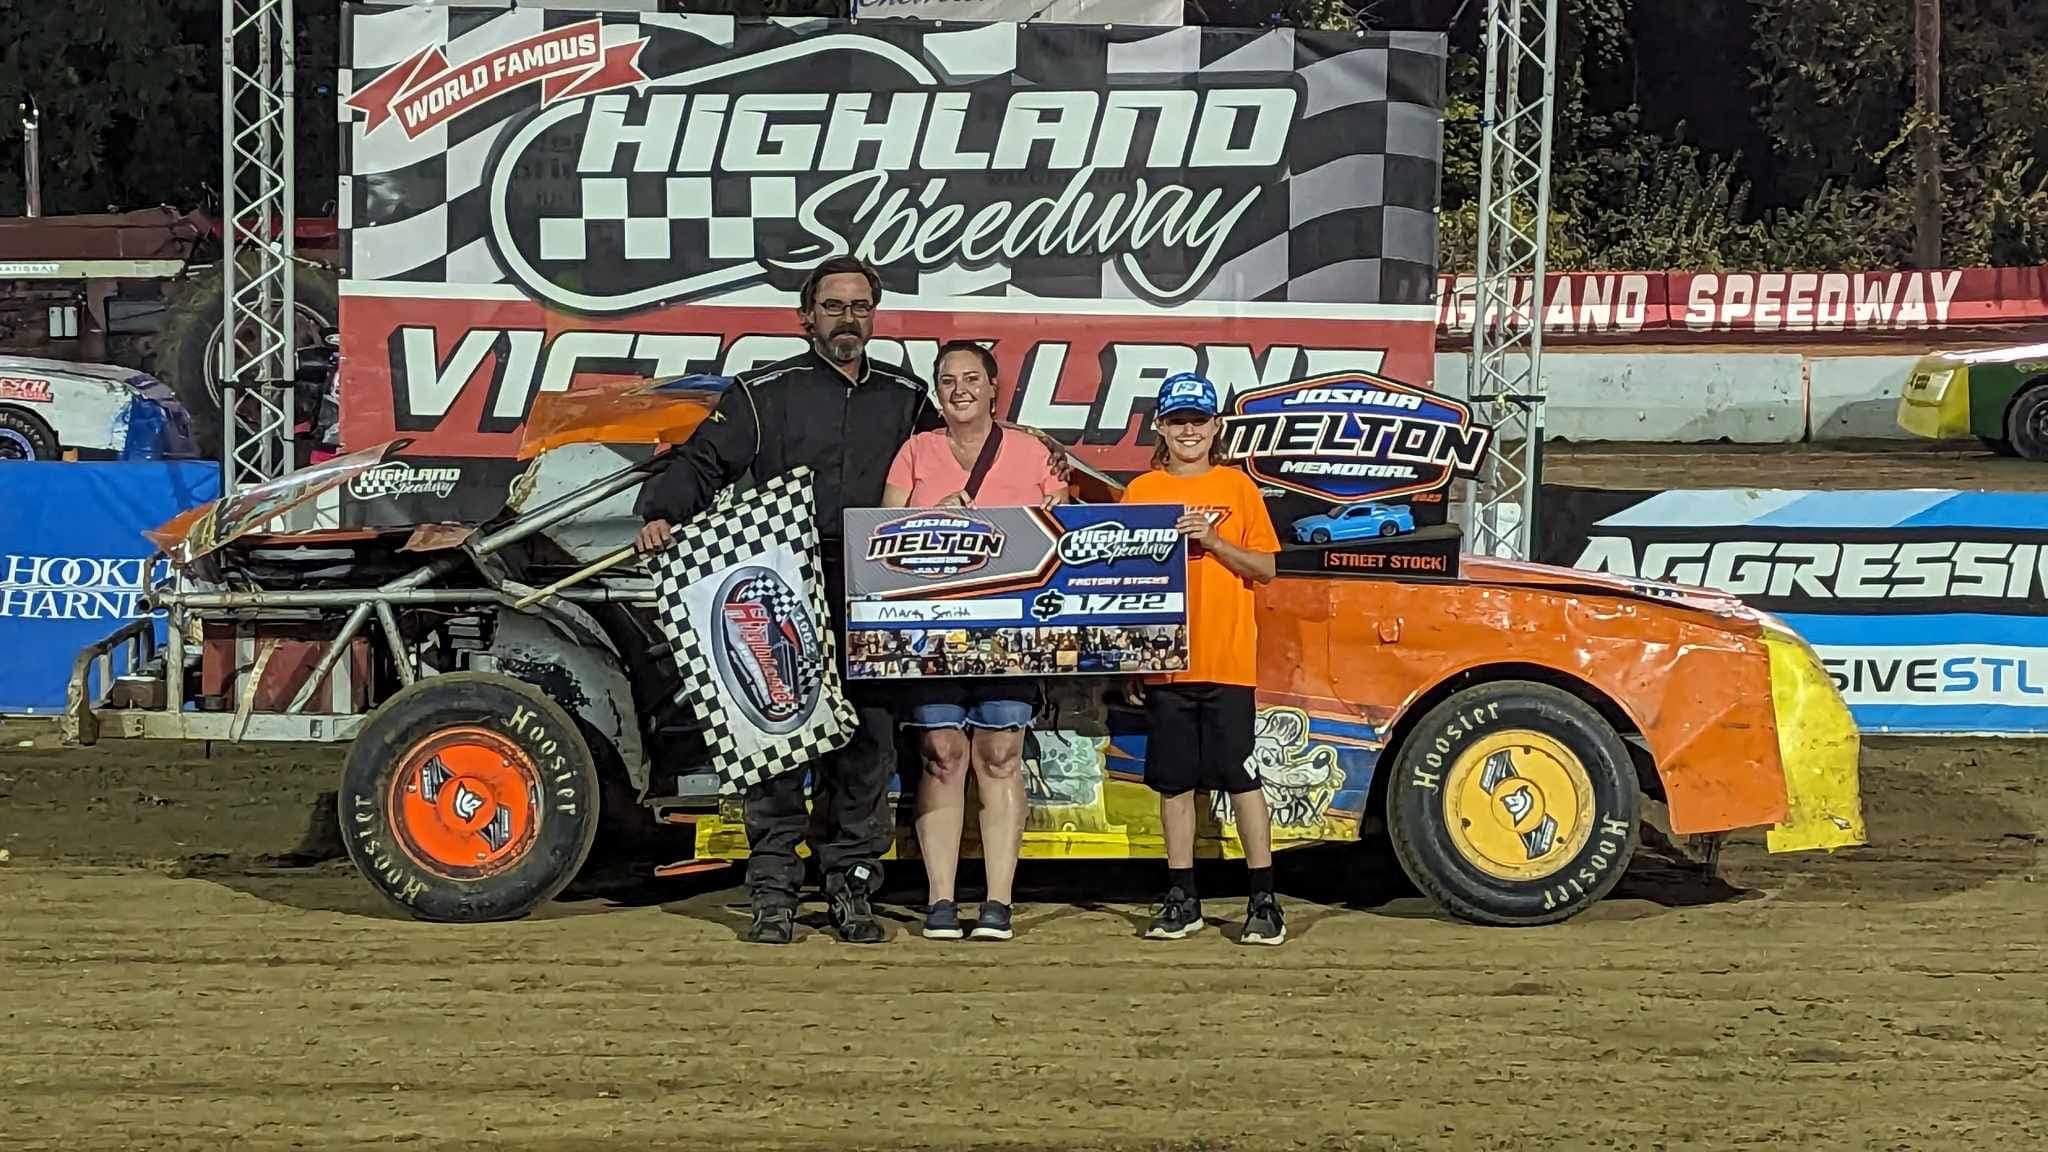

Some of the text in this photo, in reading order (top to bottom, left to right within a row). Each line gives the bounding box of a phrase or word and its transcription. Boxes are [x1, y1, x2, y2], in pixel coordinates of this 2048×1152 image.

[403, 34, 597, 128] WORLD FAMOUS
[577, 88, 1297, 173] HIGHLAND
[768, 164, 1262, 297] Speedway
[1686, 271, 1962, 332] SPEEDWAY
[1284, 389, 1422, 409] JOSHUA
[1222, 412, 1492, 470] MELTON
[1280, 461, 1419, 479] MEMORIAL
[360, 468, 461, 481] HIGHLAND
[865, 531, 1006, 560] MELTON
[1071, 529, 1179, 543] HIGHLAND
[1080, 593, 1167, 614] 1,722
[502, 704, 578, 816] Hoosier
[1412, 701, 1499, 796] Hoosier
[355, 794, 430, 905] Hoosier
[1543, 811, 1630, 911] Hoosier
